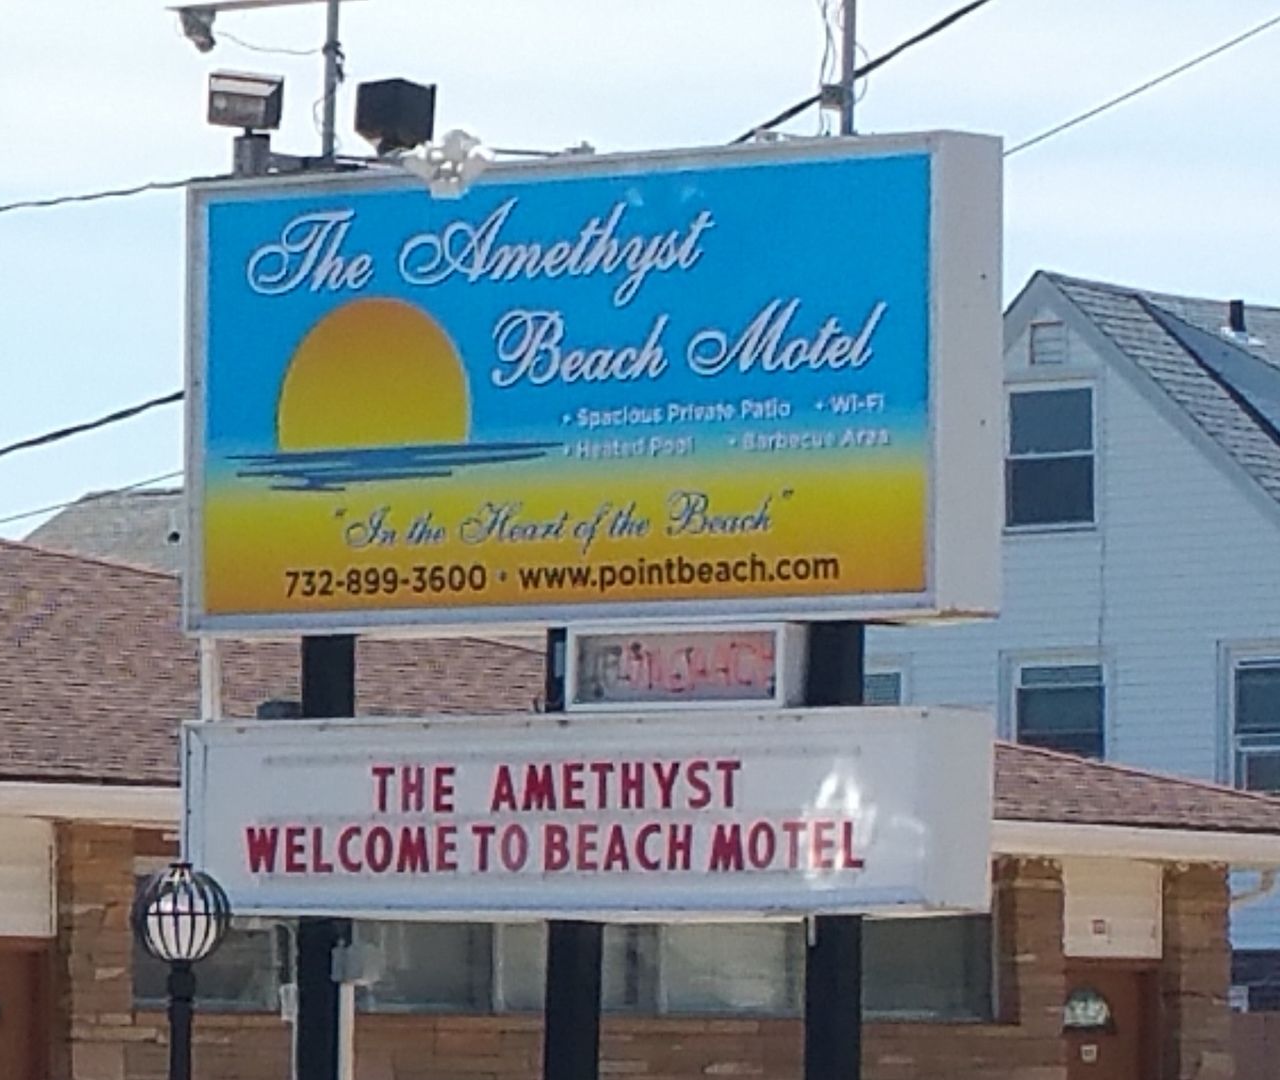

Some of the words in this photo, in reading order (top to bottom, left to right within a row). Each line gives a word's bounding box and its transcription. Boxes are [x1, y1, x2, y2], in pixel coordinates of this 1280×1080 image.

[247, 209, 373, 295] The
[399, 197, 715, 308] Amethyst
[492, 309, 669, 387] Beach
[687, 298, 887, 375] Motel
[576, 406, 663, 430] Spacious
[667, 402, 736, 423] Private
[742, 397, 791, 419] Patio
[577, 438, 645, 458] Heated
[650, 436, 696, 457] Pool
[404, 509, 446, 545] the
[460, 500, 569, 545] Heart
[572, 500, 613, 555] of
[608, 500, 650, 538] the
[285, 564, 487, 599] 732-899-3600
[518, 553, 840, 593] www.pointbeach.com
[372, 766, 456, 813] THE
[490, 760, 743, 812] AMETHYST
[245, 824, 458, 874] WELCOME
[471, 825, 529, 873] TO
[543, 822, 694, 872] BEACH
[708, 820, 866, 871] MOTEL
